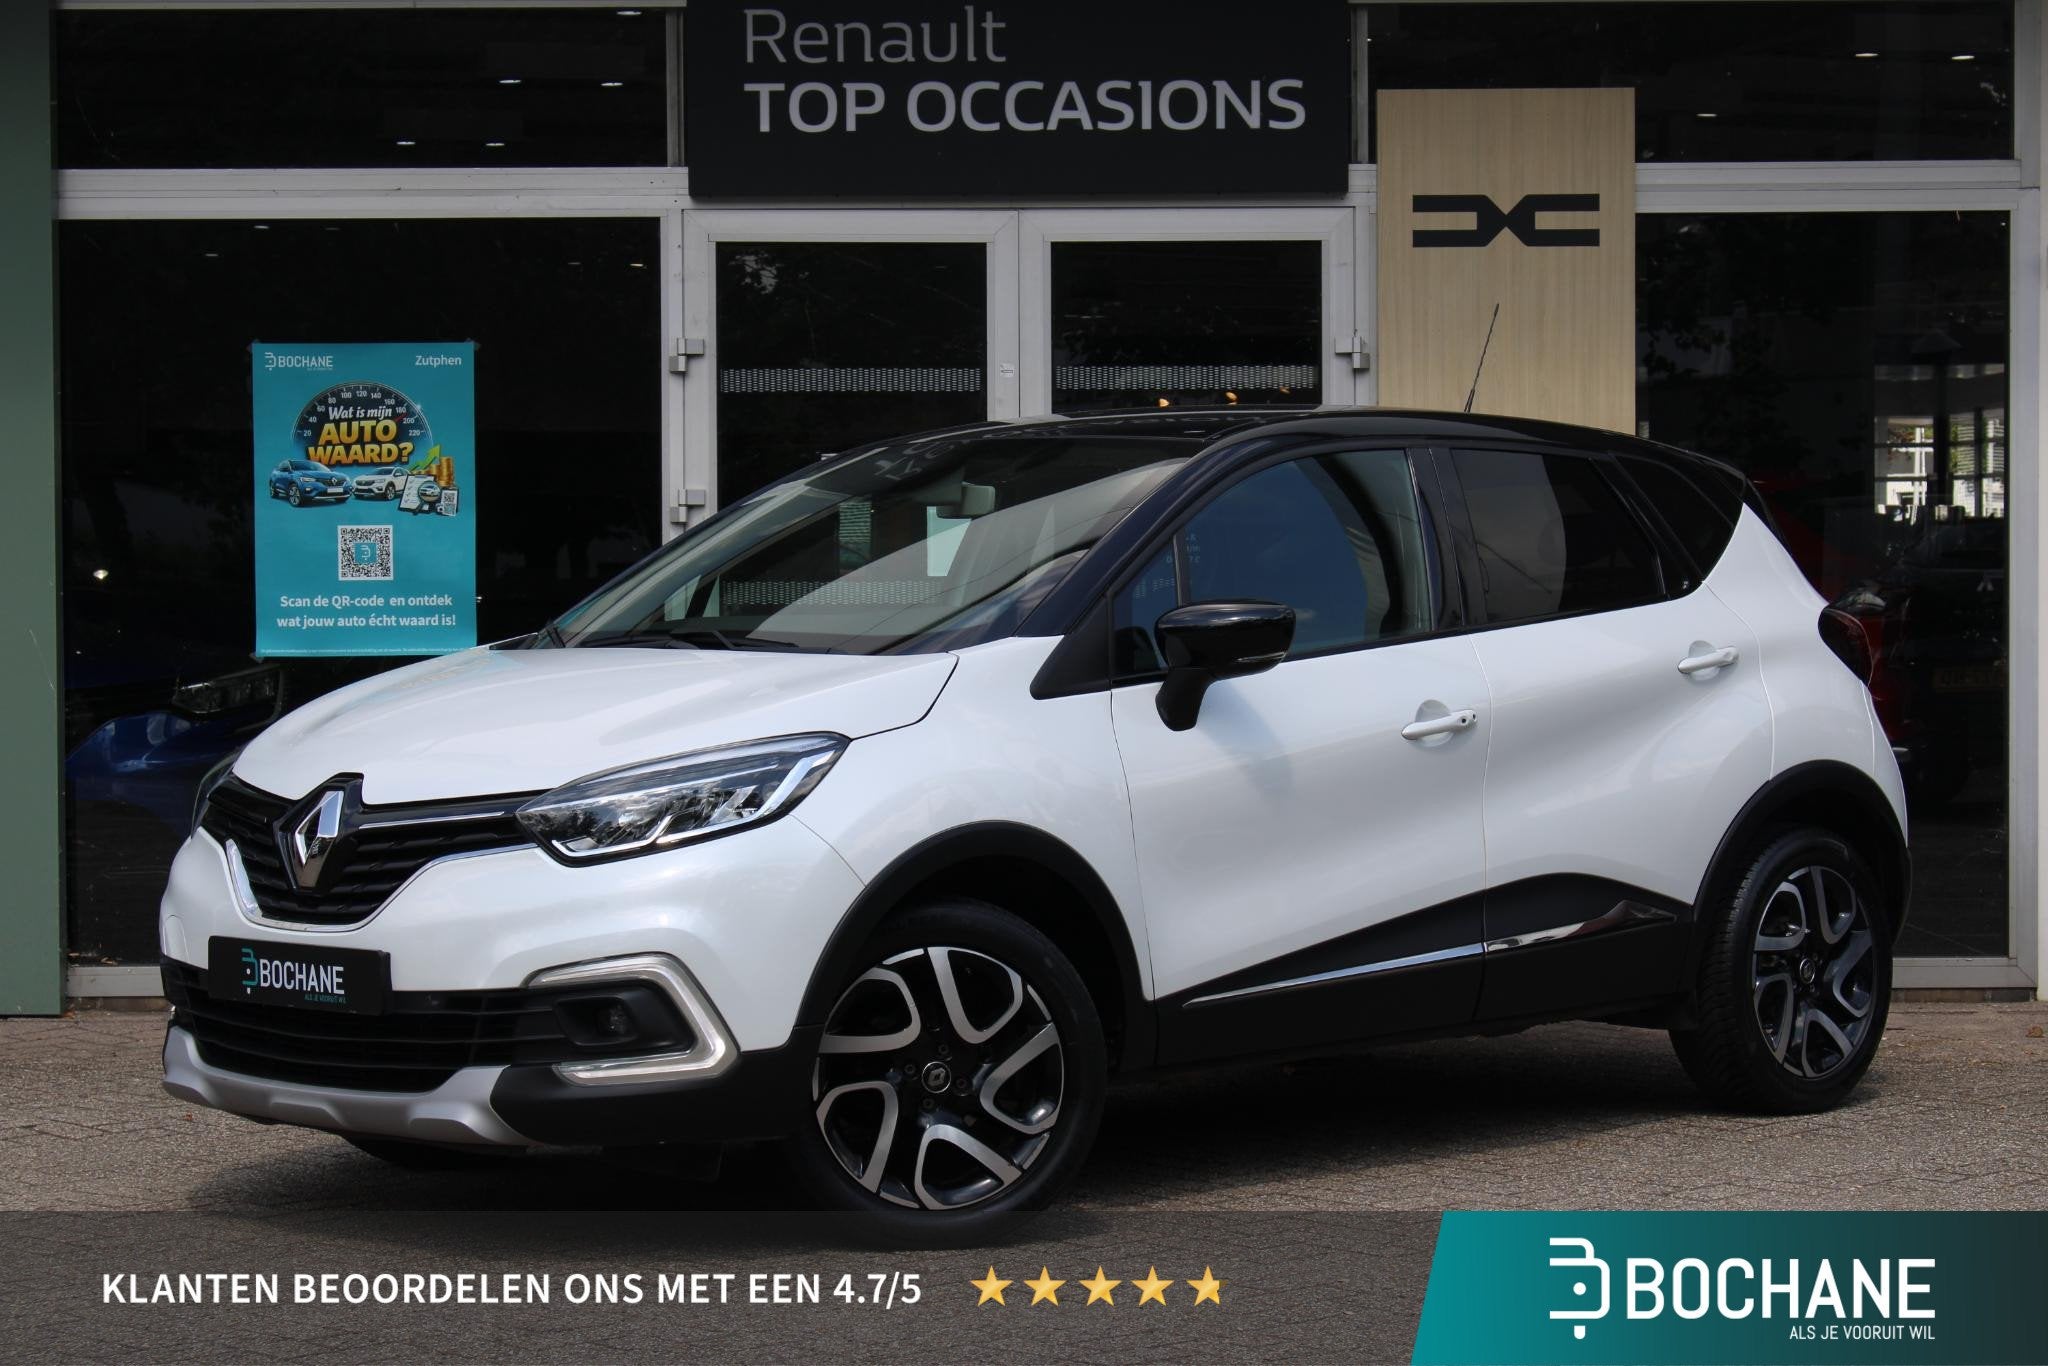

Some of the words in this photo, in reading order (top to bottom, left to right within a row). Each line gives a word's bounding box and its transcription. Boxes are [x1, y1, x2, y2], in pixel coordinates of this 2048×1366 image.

[744, 5, 1007, 64] Renault
[744, 81, 886, 134] TOP
[907, 78, 1306, 133] OCCASIONS
[278, 355, 333, 368] BOCHANE
[415, 355, 462, 368] Zutphen
[328, 406, 354, 419] Wat
[356, 406, 365, 418] is
[367, 406, 392, 420] mijn
[318, 420, 397, 445] AUTO
[307, 442, 414, 465] WAARD?
[280, 596, 311, 607] Scan
[313, 595, 329, 607] de
[331, 595, 384, 609] QR-code
[390, 597, 403, 606] en
[405, 595, 452, 606] ontdek
[277, 617, 301, 627] wat
[302, 616, 335, 629] jouw
[337, 617, 366, 627] auto
[369, 614, 397, 626] écht
[399, 614, 439, 626] waard
[441, 614, 456, 626] is!
[260, 959, 345, 995] BOCHANE
